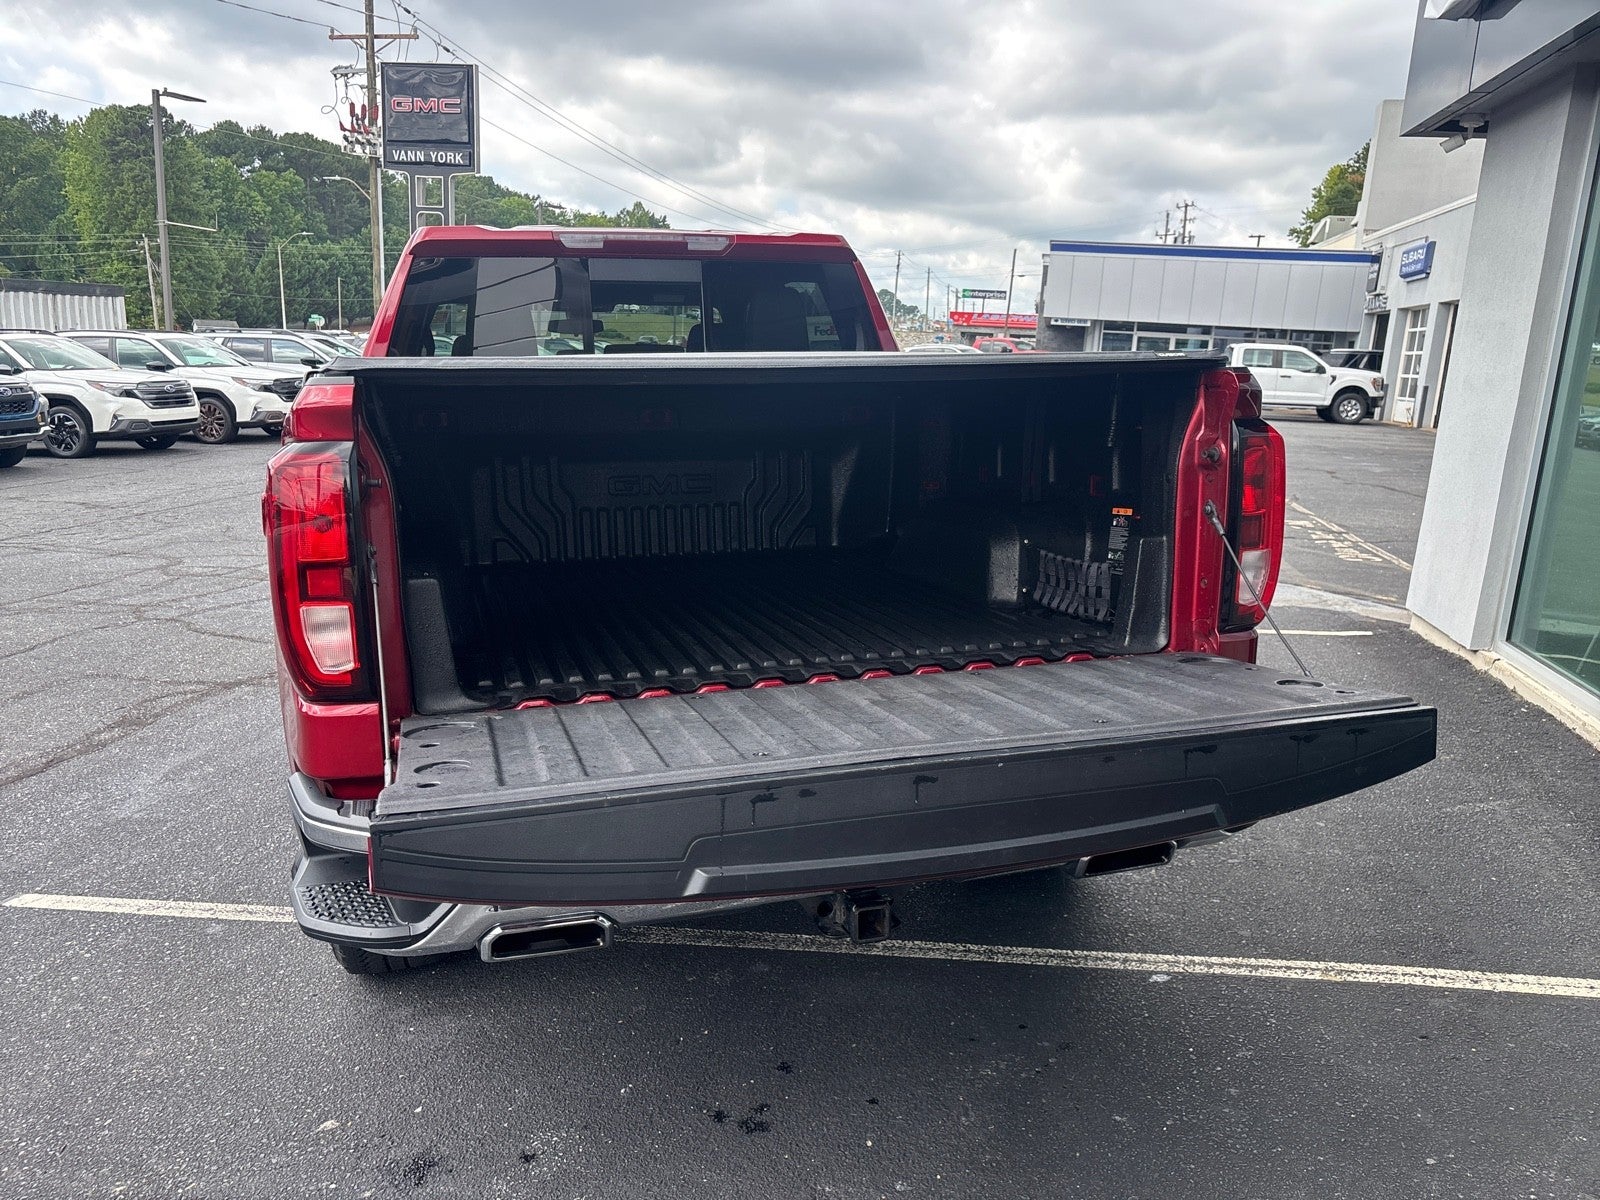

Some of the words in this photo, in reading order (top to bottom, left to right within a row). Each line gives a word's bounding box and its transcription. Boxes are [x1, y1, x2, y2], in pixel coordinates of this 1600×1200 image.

[391, 97, 461, 113] GMC
[392, 149, 425, 162] VANN
[430, 151, 464, 164] YORK
[1402, 248, 1426, 264] SUBARU
[962, 290, 1006, 299] enterprise
[608, 474, 712, 496] GMC
